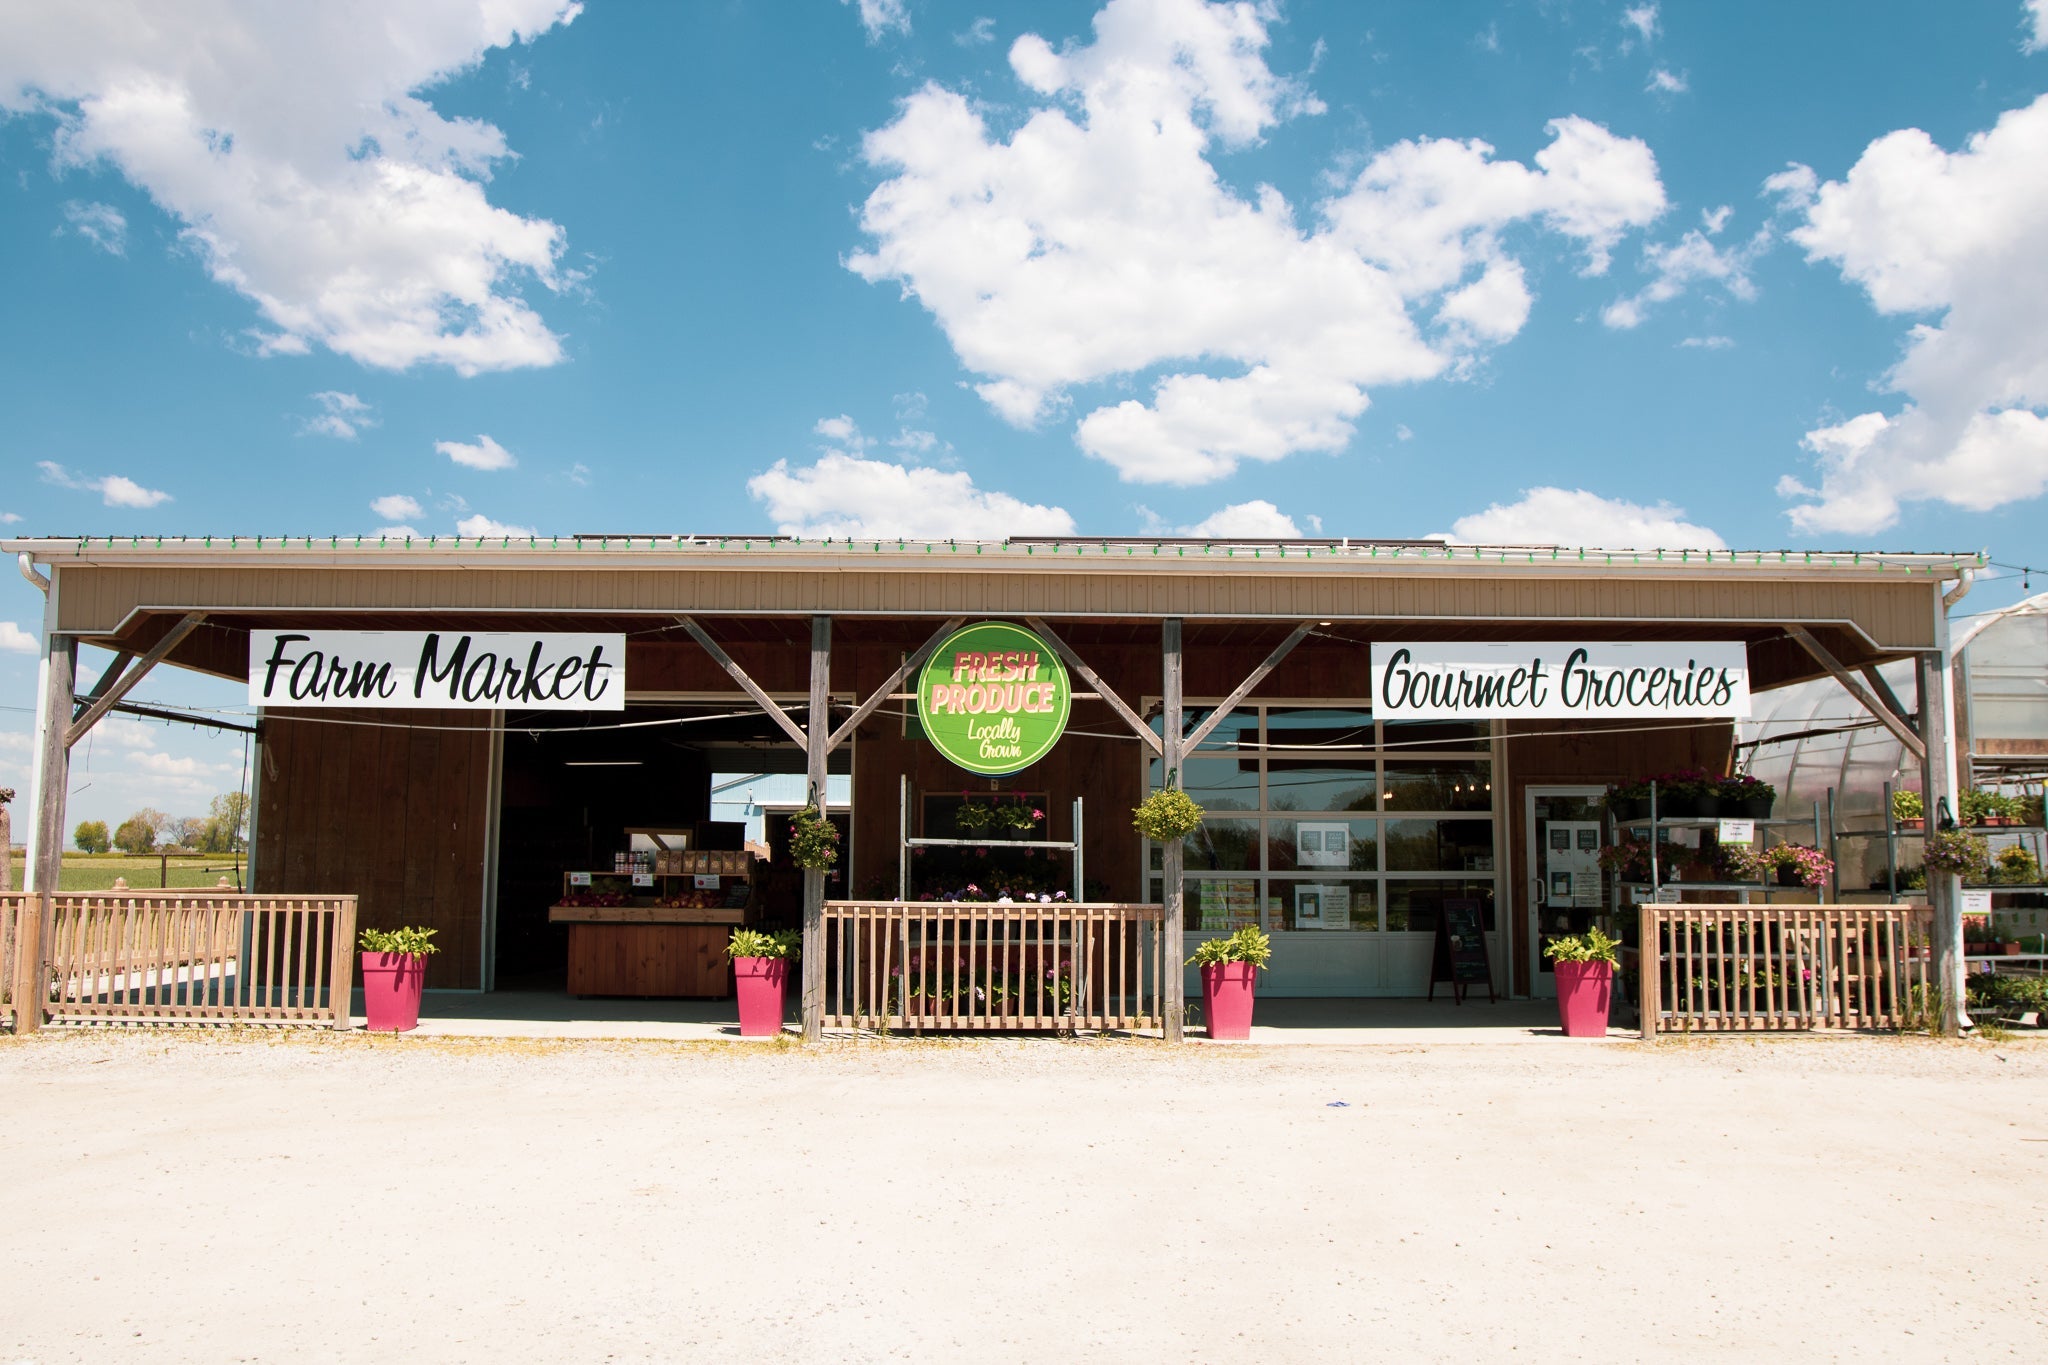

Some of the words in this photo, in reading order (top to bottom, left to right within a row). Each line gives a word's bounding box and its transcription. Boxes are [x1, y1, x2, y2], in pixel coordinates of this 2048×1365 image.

[263, 634, 396, 703] Farm
[413, 633, 613, 704] Market
[952, 651, 1041, 683] FRESH
[1382, 648, 1549, 711] Gourmet
[1560, 648, 1738, 711] Groceries
[929, 682, 1056, 715] PRODUCE
[967, 717, 1021, 744] Locally
[979, 738, 1022, 759] Grown
